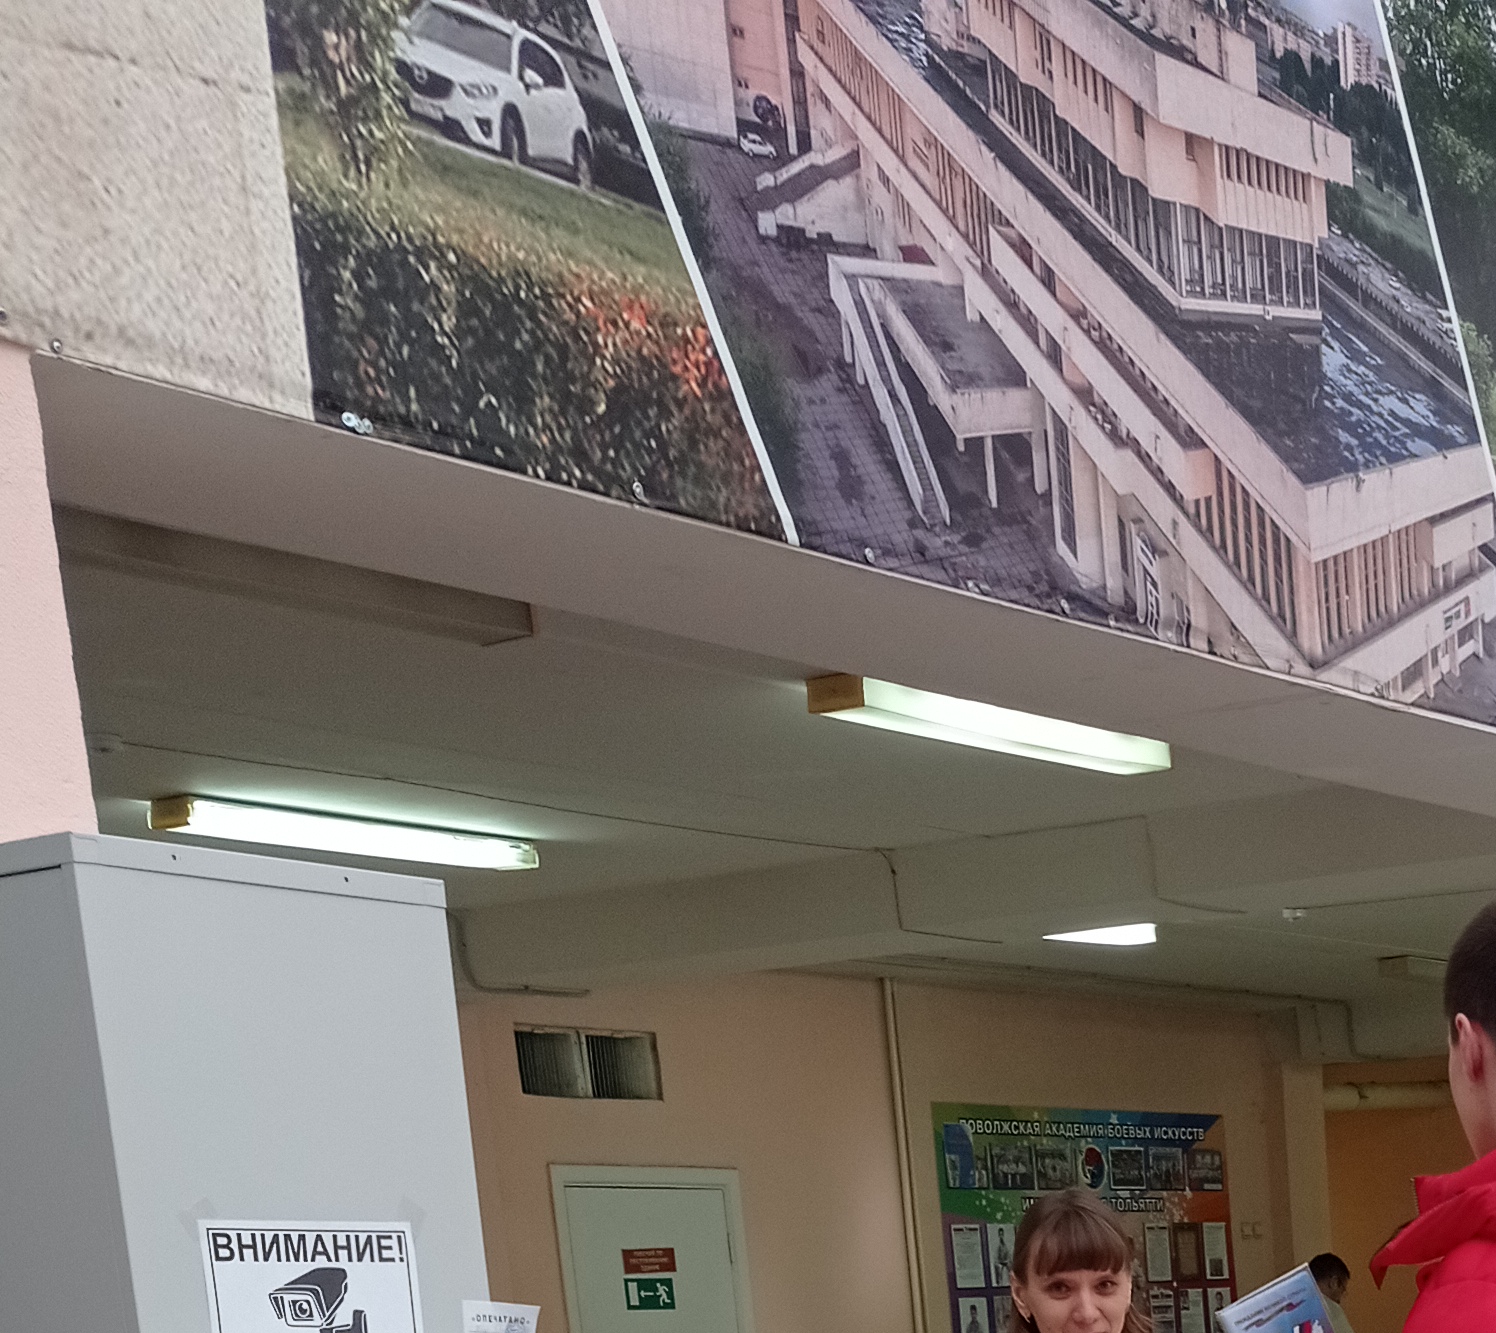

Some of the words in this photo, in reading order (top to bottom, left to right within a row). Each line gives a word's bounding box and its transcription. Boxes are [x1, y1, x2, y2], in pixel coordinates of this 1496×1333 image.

[1044, 1122, 1103, 1139] АКАДЕМИЯ
[1107, 1124, 1151, 1139] БОЕВЫХ
[1154, 1126, 1205, 1140] ИСКУССТВ
[1111, 1198, 1164, 1212] ТОЛЬЯТТИ
[211, 1232, 405, 1263] ВНИМАНИЕ!
